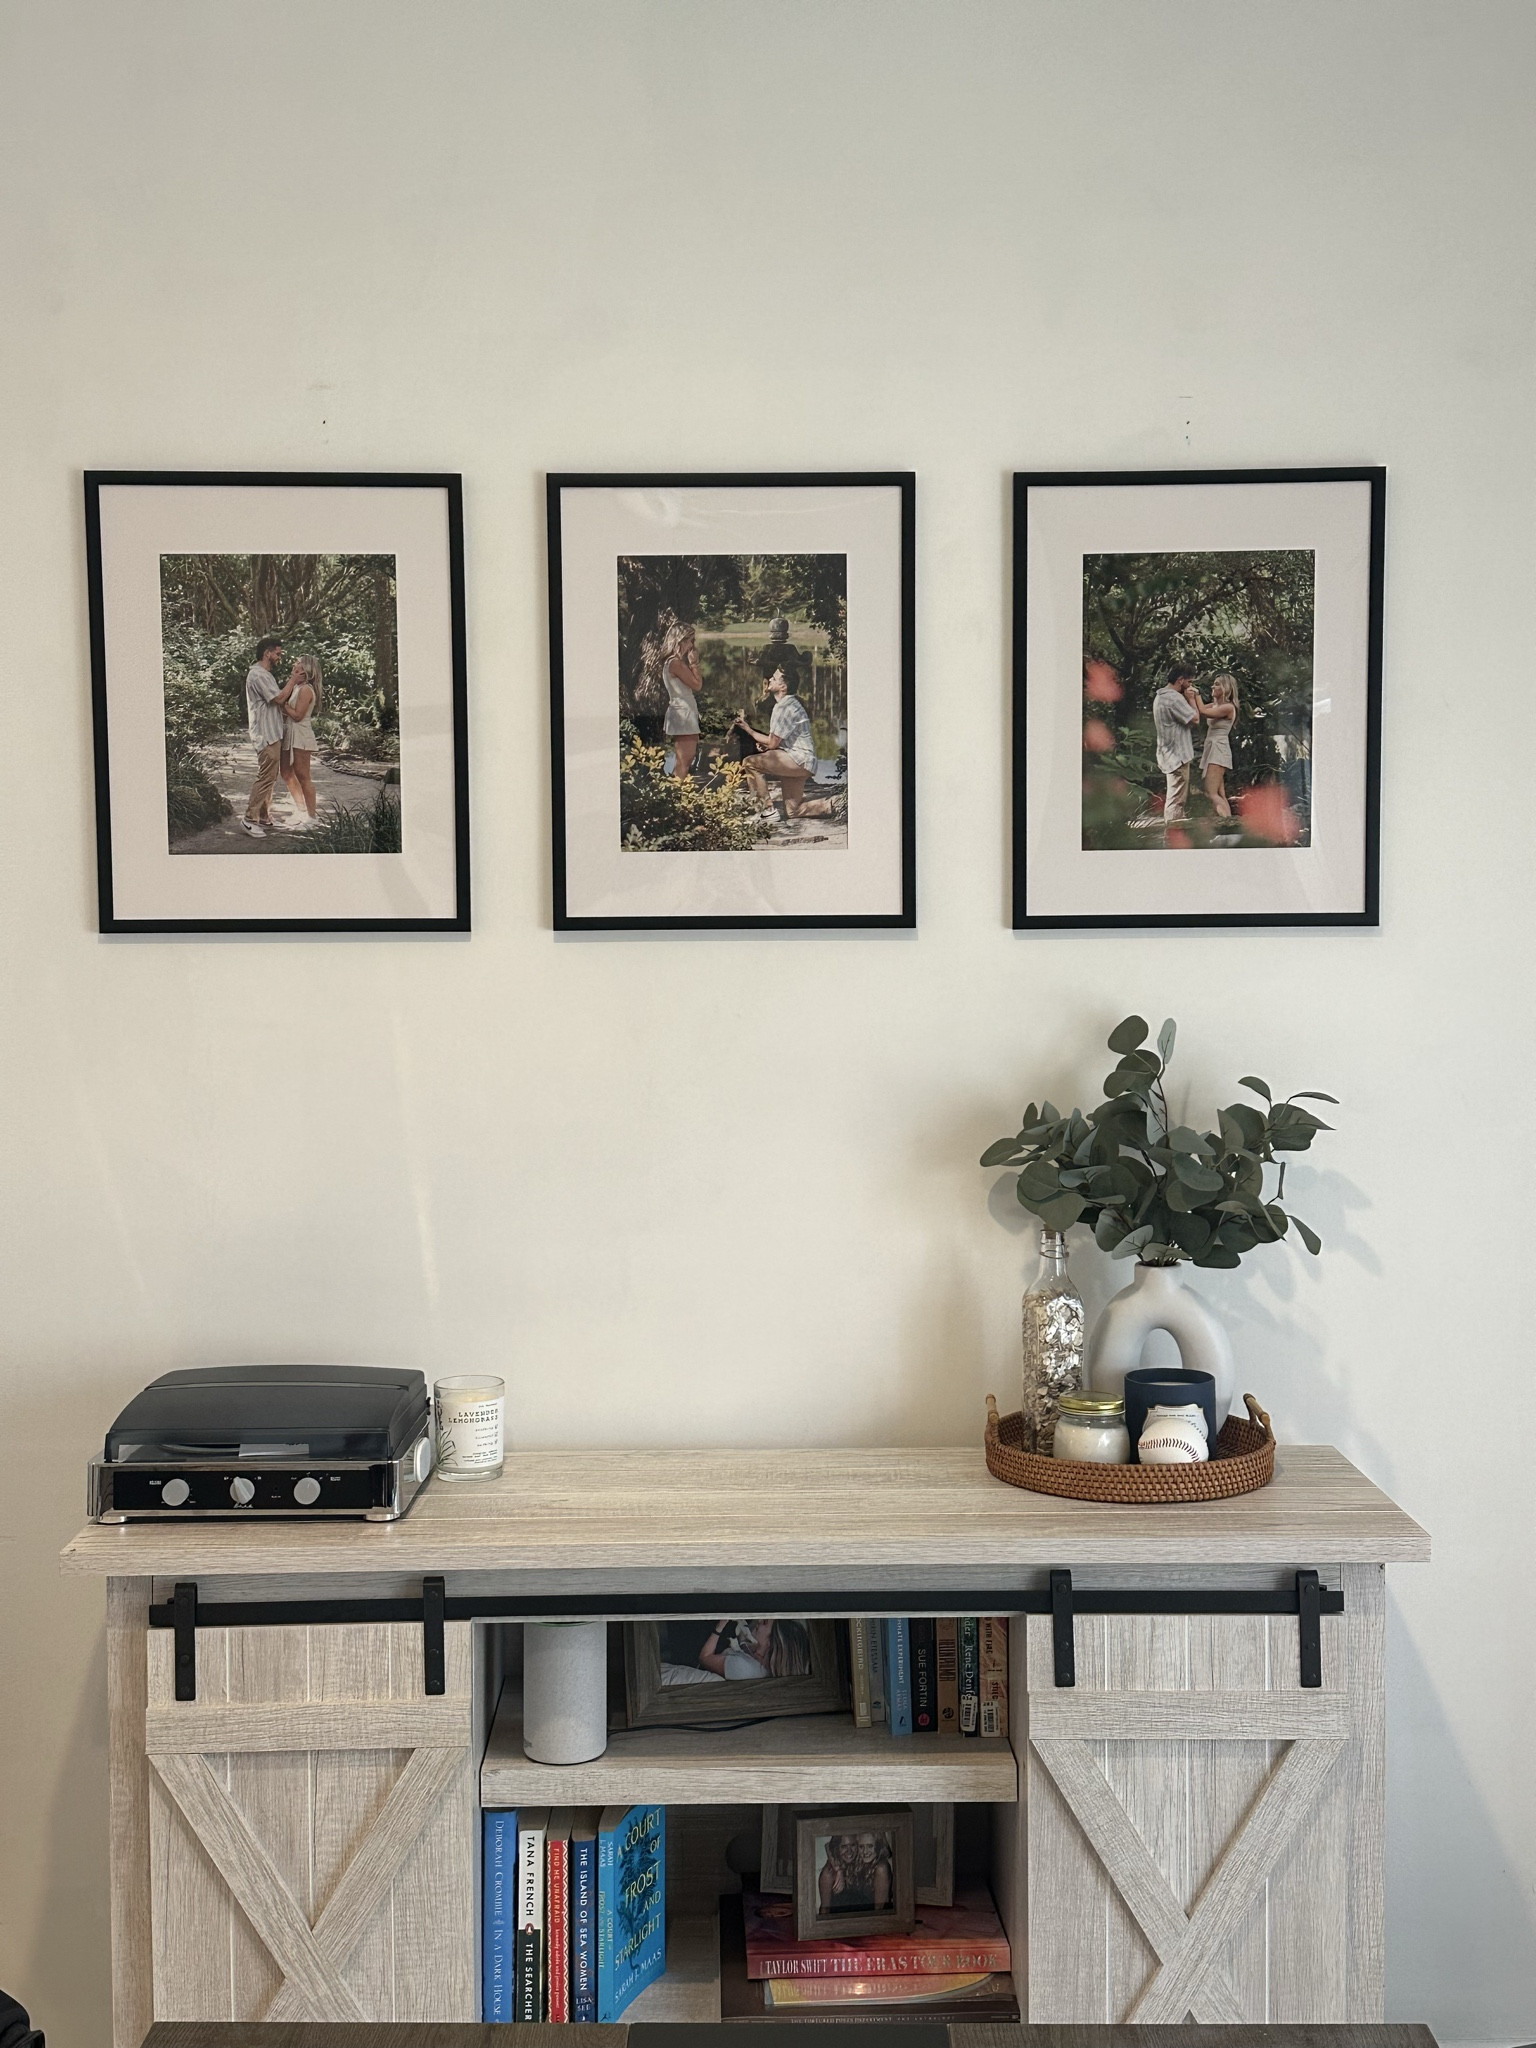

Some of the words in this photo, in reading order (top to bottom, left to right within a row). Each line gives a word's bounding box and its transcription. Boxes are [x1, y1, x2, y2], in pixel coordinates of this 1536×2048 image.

[917, 1649, 927, 1668] SUE
[964, 1645, 974, 1668] Rene
[918, 1671, 927, 1708] FORTIN
[494, 1820, 505, 1867] DEBORAH
[625, 1808, 661, 1851] COURT
[650, 1836, 661, 1854] OF
[526, 1836, 535, 1867] TANA
[579, 1848, 588, 1867] THE
[494, 1872, 504, 1916] CROMBIE
[525, 1872, 535, 1917] FRENCH
[579, 1870, 588, 1906] ISLAND
[625, 1860, 662, 1908] FROST
[553, 1883, 561, 1924] UNAFRAID
[579, 1910, 588, 1924] OF
[642, 1890, 661, 1914] AND
[524, 1943, 534, 1963] THE
[579, 1928, 588, 1947] SEA
[614, 1913, 662, 1972] STARLIGHT
[493, 1955, 504, 1980] DARK
[579, 1950, 588, 1991] WOMEN
[614, 1974, 634, 2005] SARAH
[641, 1947, 662, 1972] MAAS
[765, 1959, 799, 1975] TAYLOR
[800, 1958, 827, 1973] SWIFT
[830, 1957, 863, 1972] THE
[867, 1956, 908, 1972] ERAS
[493, 1985, 504, 2016] HOUSE
[524, 1967, 533, 2021] SEARCHER
